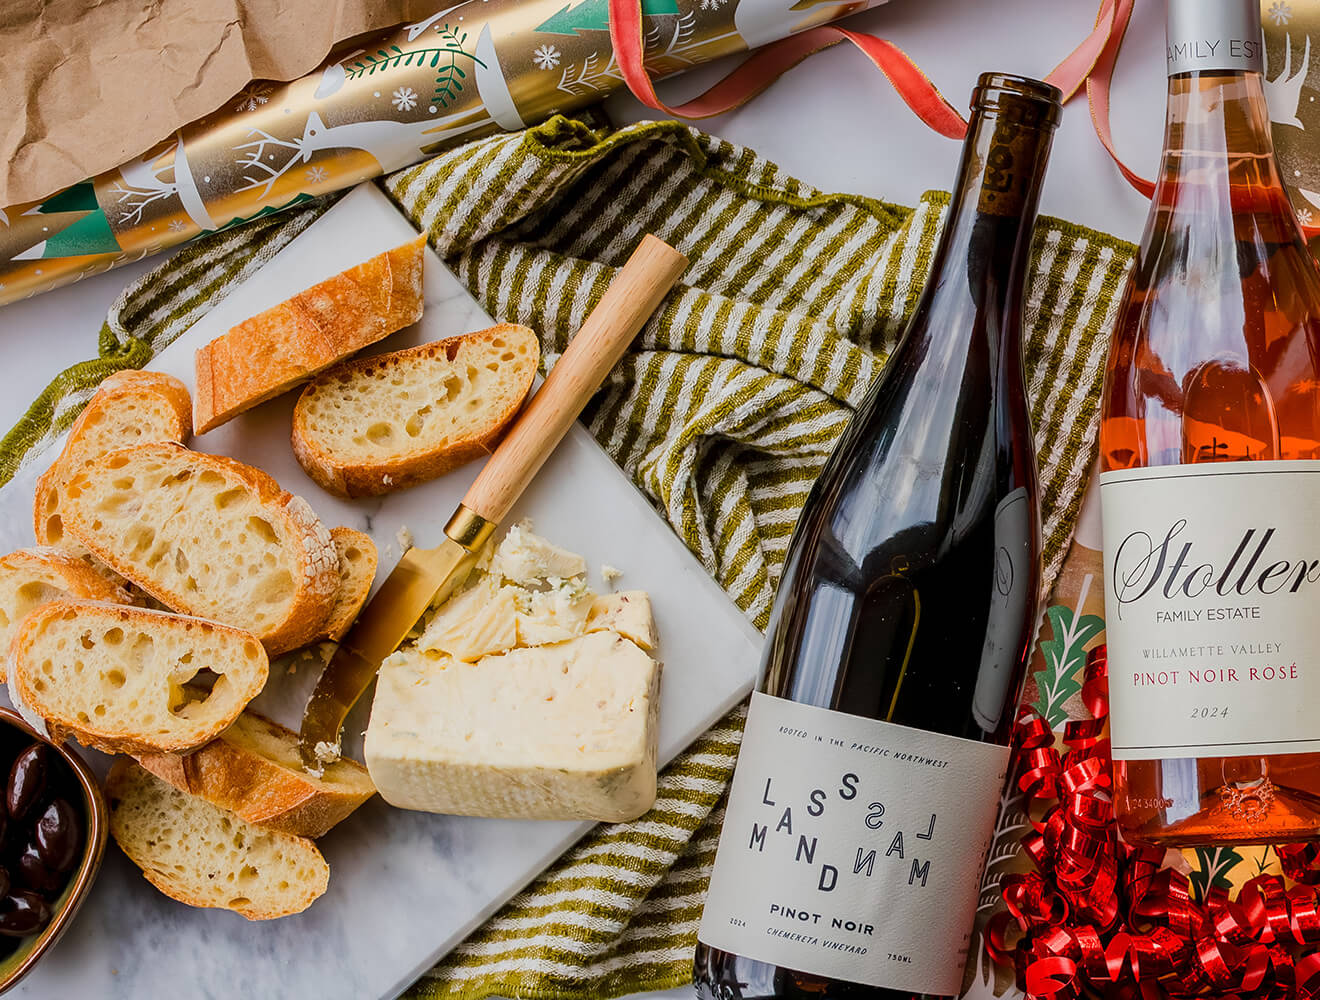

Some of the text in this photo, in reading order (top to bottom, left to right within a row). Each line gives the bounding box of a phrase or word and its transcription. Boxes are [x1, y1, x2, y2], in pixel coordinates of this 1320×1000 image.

[1167, 40, 1262, 62] AMILY EST
[1113, 519, 1320, 621] Stoller
[1156, 607, 1260, 623] FAMILY ESTATE
[1142, 642, 1281, 659] WILLAMETTE VALLEY
[1133, 662, 1298, 686] PINOT NOIR ROSÉ
[1190, 706, 1229, 719] 2024
[829, 738, 844, 747] THE
[851, 742, 890, 757] PACIFIC
[893, 751, 949, 769] NORTHWEST
[770, 904, 875, 936] PINOT NOIR
[766, 927, 868, 956] CHEMEKETA VINEYARD
[887, 953, 912, 964] 750ML
